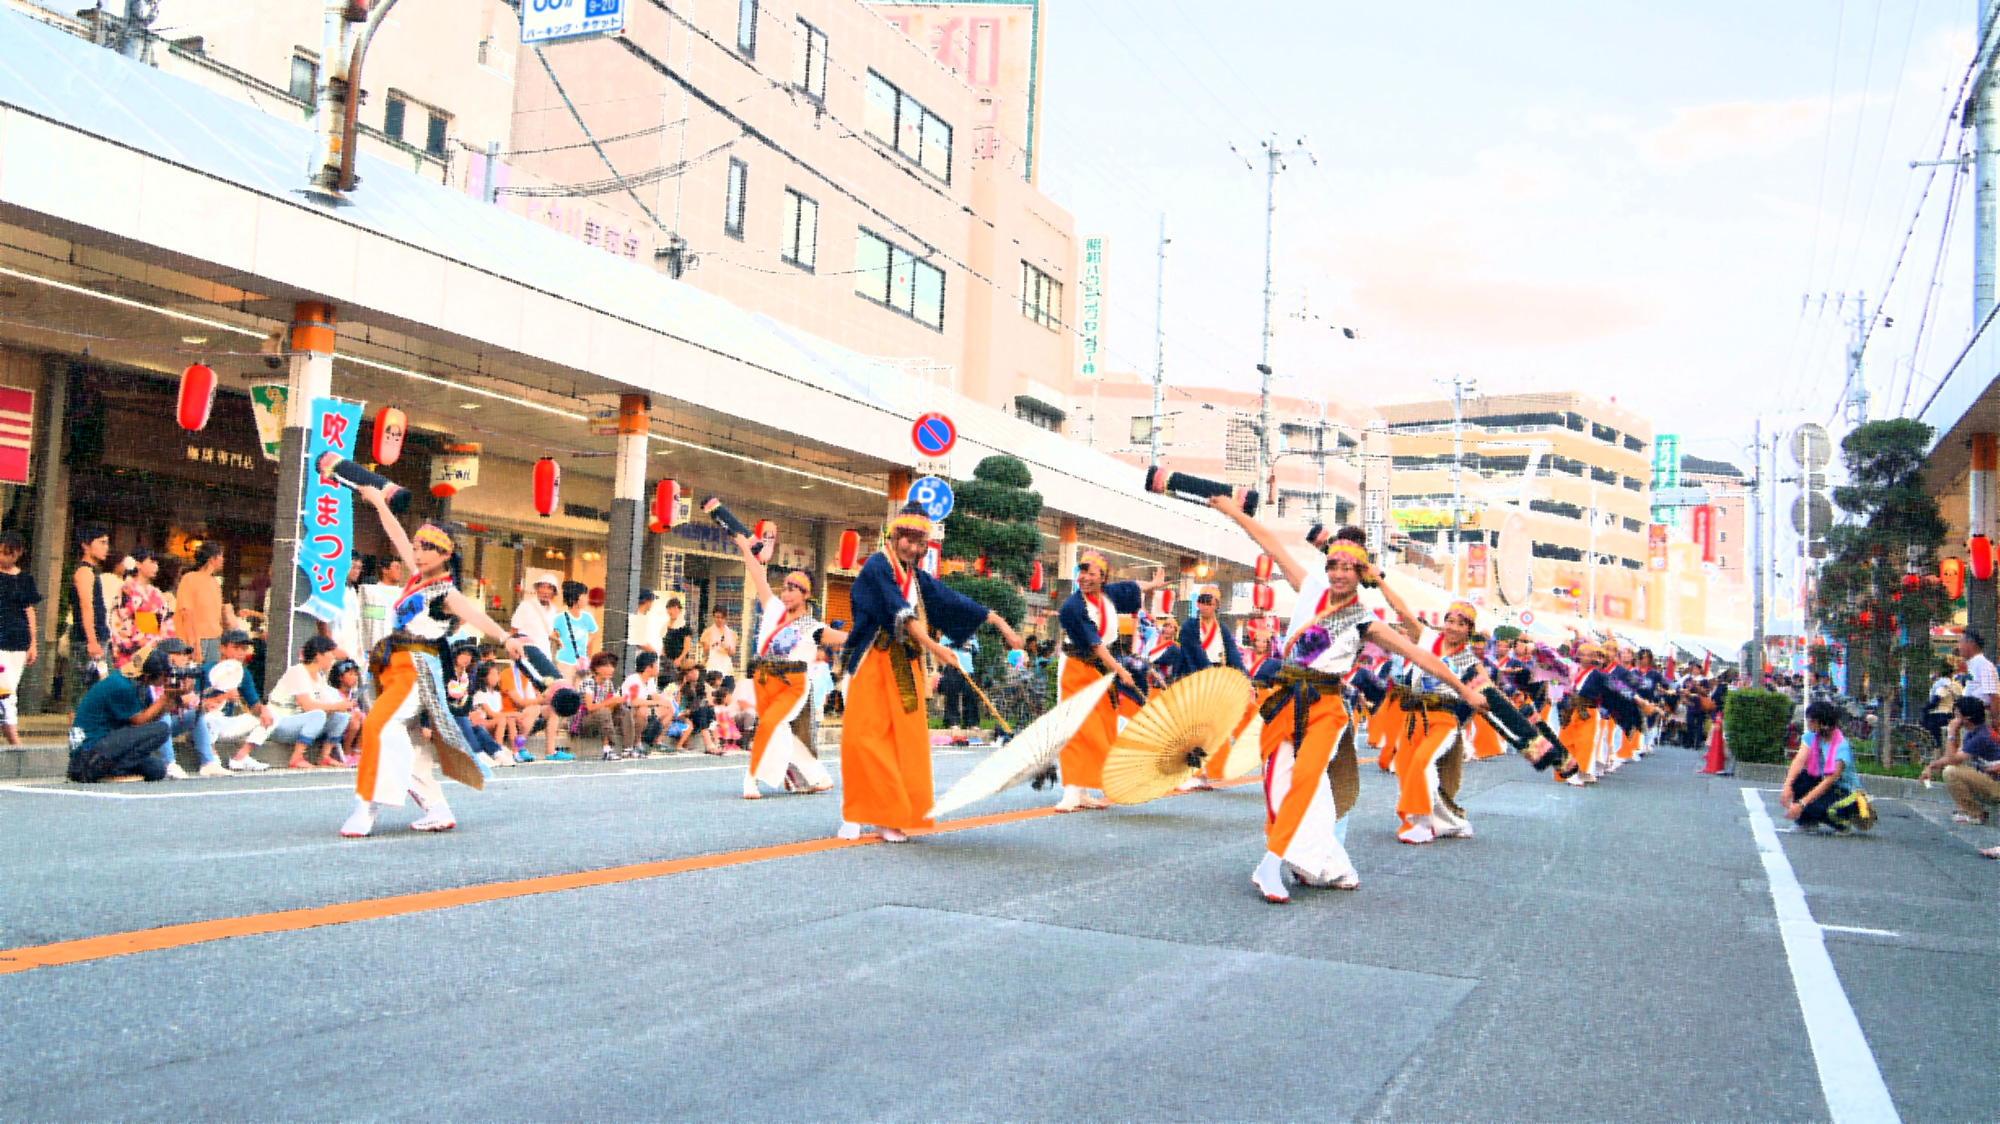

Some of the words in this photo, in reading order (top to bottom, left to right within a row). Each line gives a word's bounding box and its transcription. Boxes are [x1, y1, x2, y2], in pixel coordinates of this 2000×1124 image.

[526, 17, 621, 38] パーキング・チケット
[918, 487, 936, 504] P
